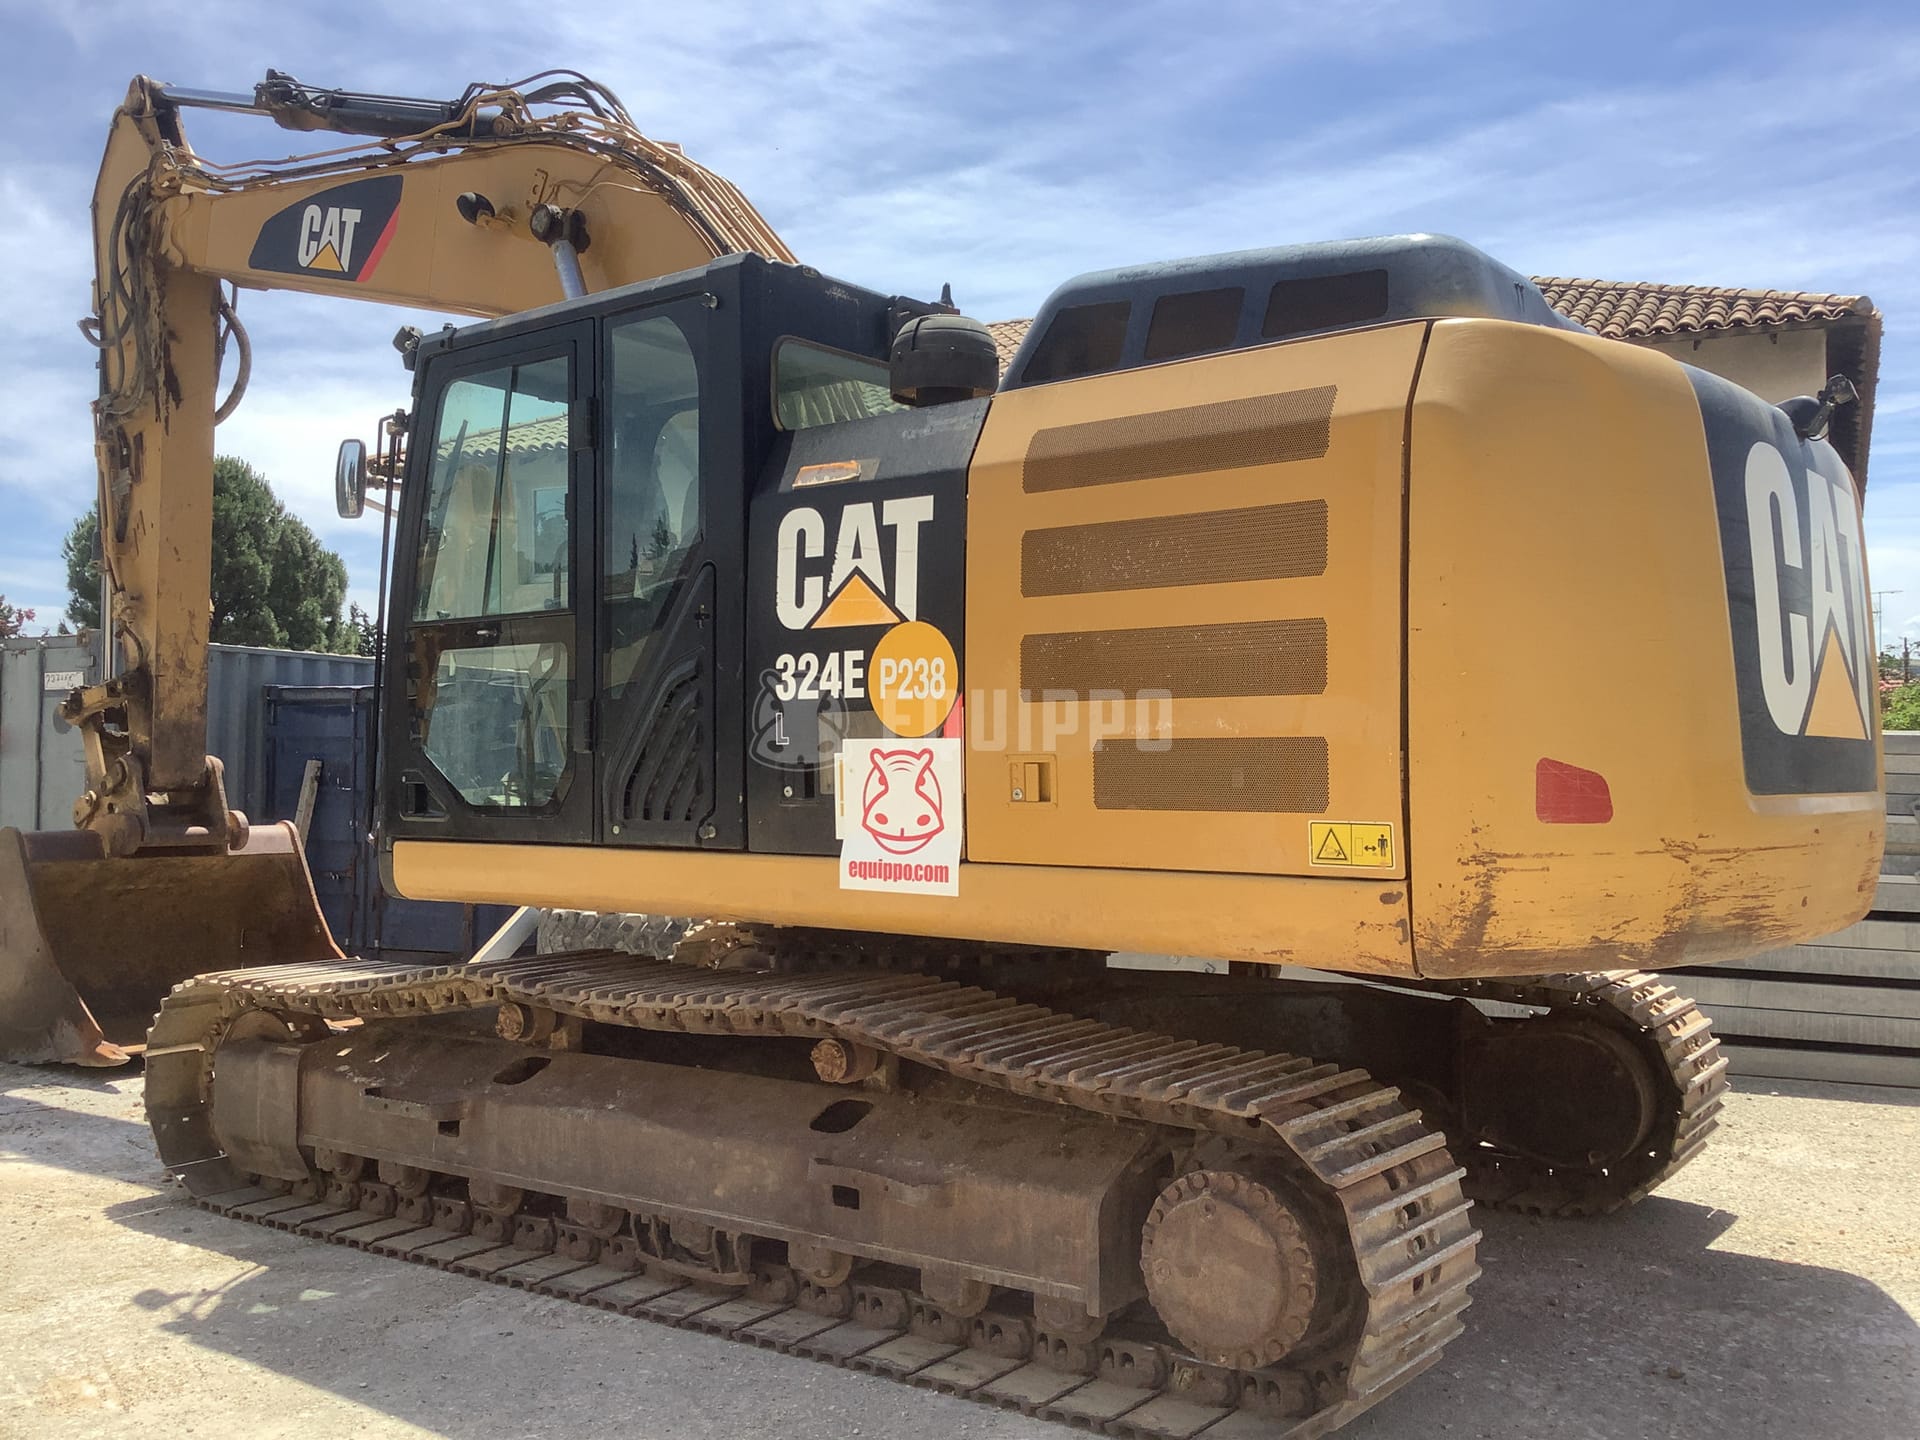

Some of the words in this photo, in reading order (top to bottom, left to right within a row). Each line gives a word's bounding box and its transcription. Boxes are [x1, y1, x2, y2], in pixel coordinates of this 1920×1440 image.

[298, 204, 362, 273] CAT
[776, 495, 934, 630] CAT
[1745, 441, 1871, 741] CAT
[775, 650, 865, 701] 324E
[879, 656, 946, 700] P238
[775, 712, 790, 745] L
[848, 859, 950, 884] equippo.com
